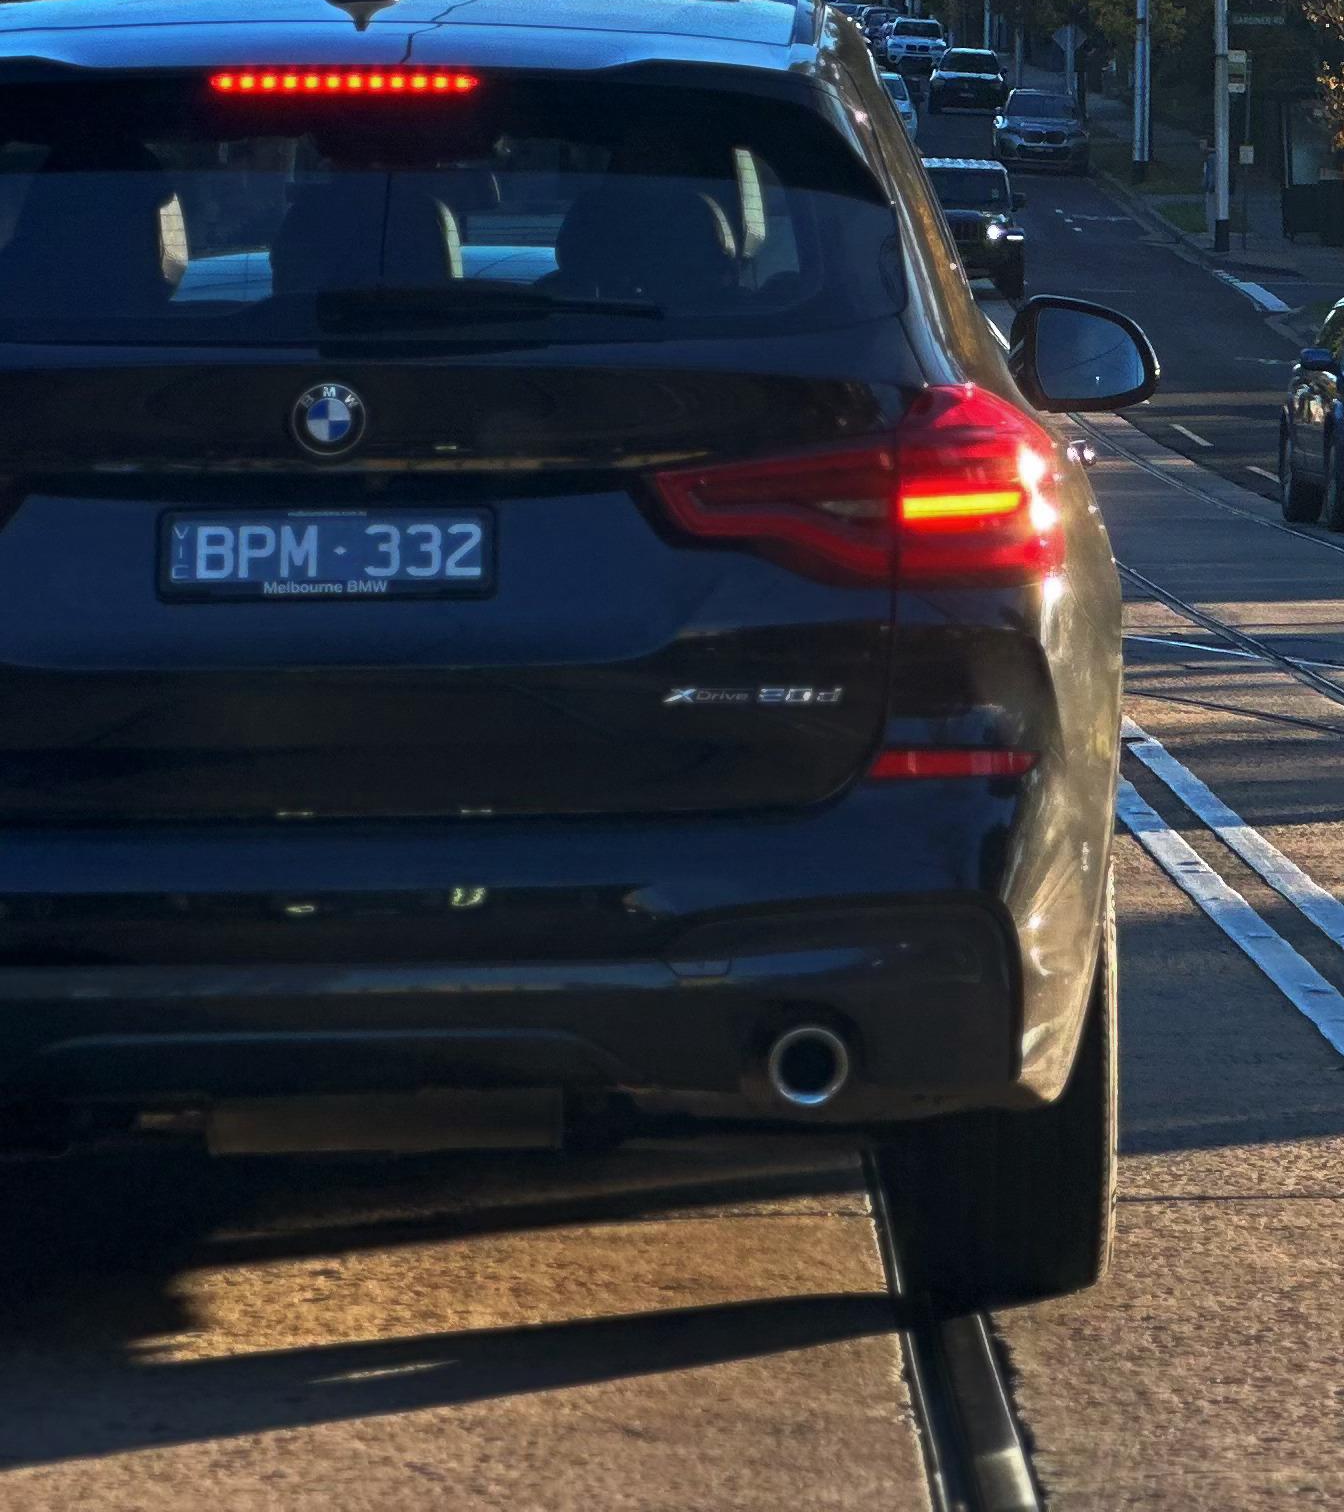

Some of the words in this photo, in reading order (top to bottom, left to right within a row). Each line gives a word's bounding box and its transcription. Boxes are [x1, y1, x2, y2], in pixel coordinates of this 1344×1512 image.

[301, 386, 360, 408] BMW
[196, 525, 318, 579] BPM
[364, 524, 482, 577] 332
[263, 580, 343, 594] Melbourne
[347, 580, 388, 593] BMW
